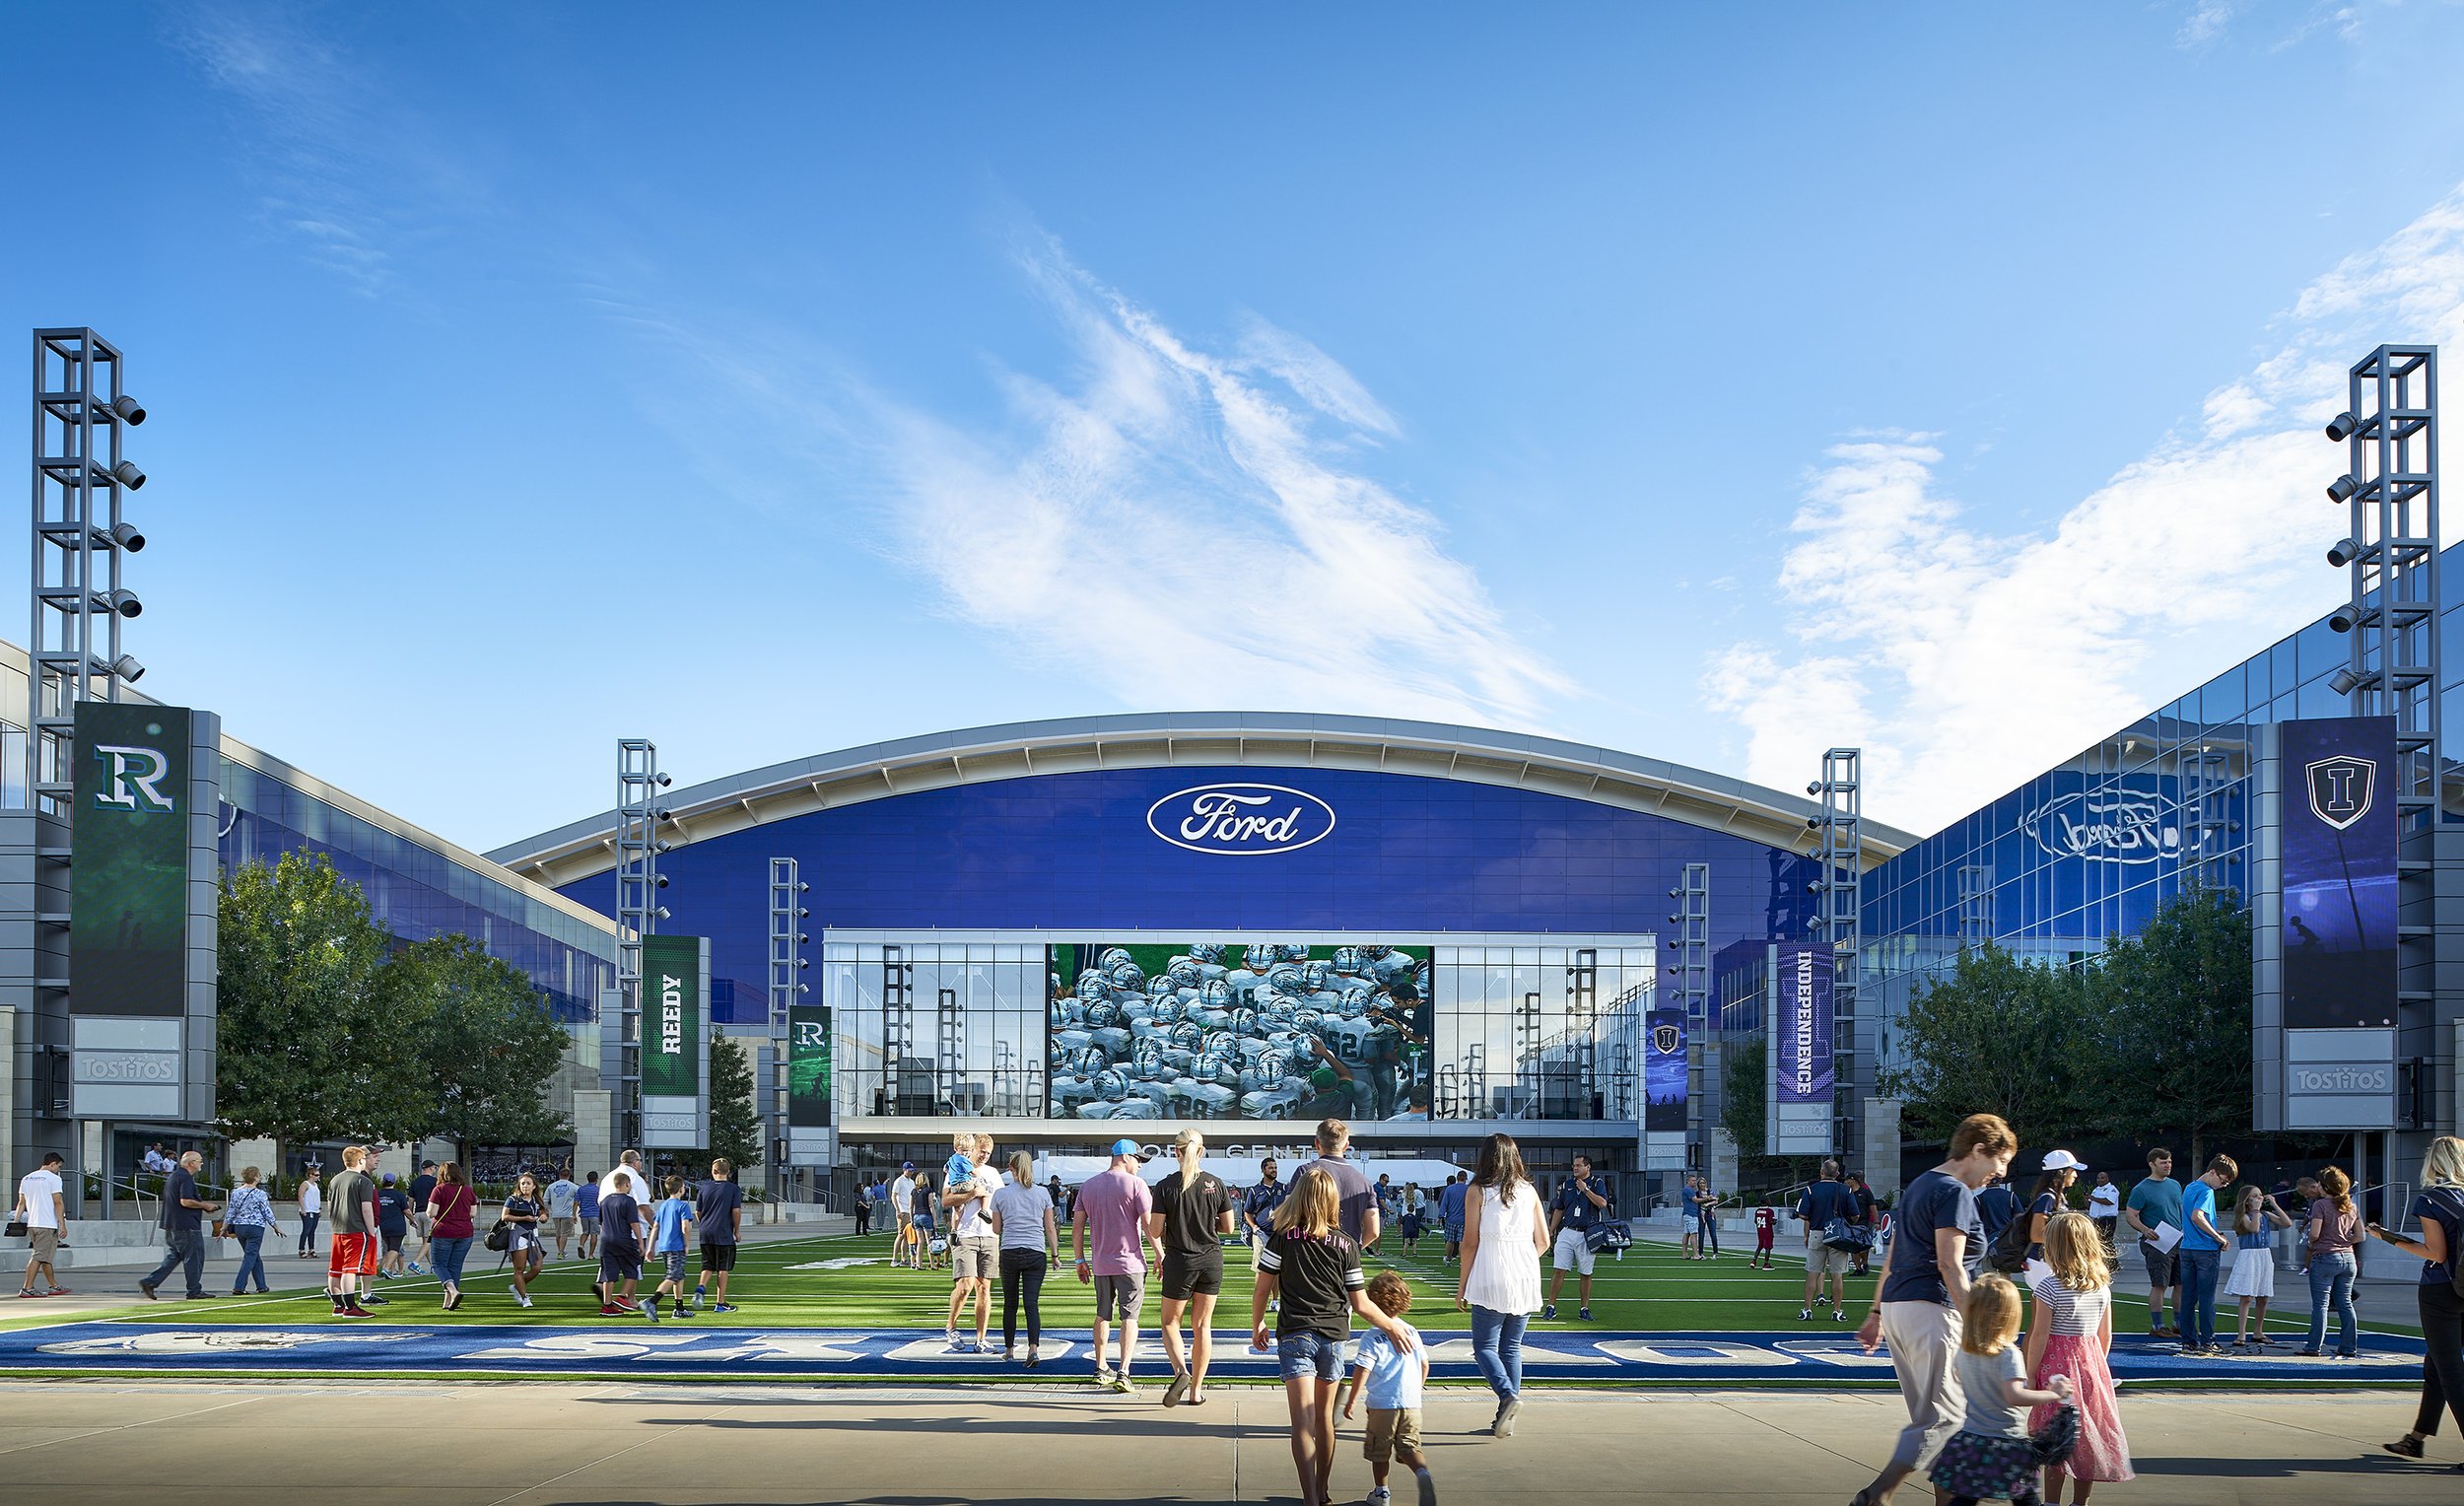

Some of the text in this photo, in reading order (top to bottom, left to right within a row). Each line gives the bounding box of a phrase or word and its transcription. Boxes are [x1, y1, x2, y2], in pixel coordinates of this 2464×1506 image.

[1180, 792, 1303, 843] Ford
[661, 974, 682, 1055] REEDY
[1797, 951, 1813, 1094] INDEPENDENCE
[1226, 1144, 1356, 1160] CENTR
[1324, 1233, 1352, 1255] PINK
